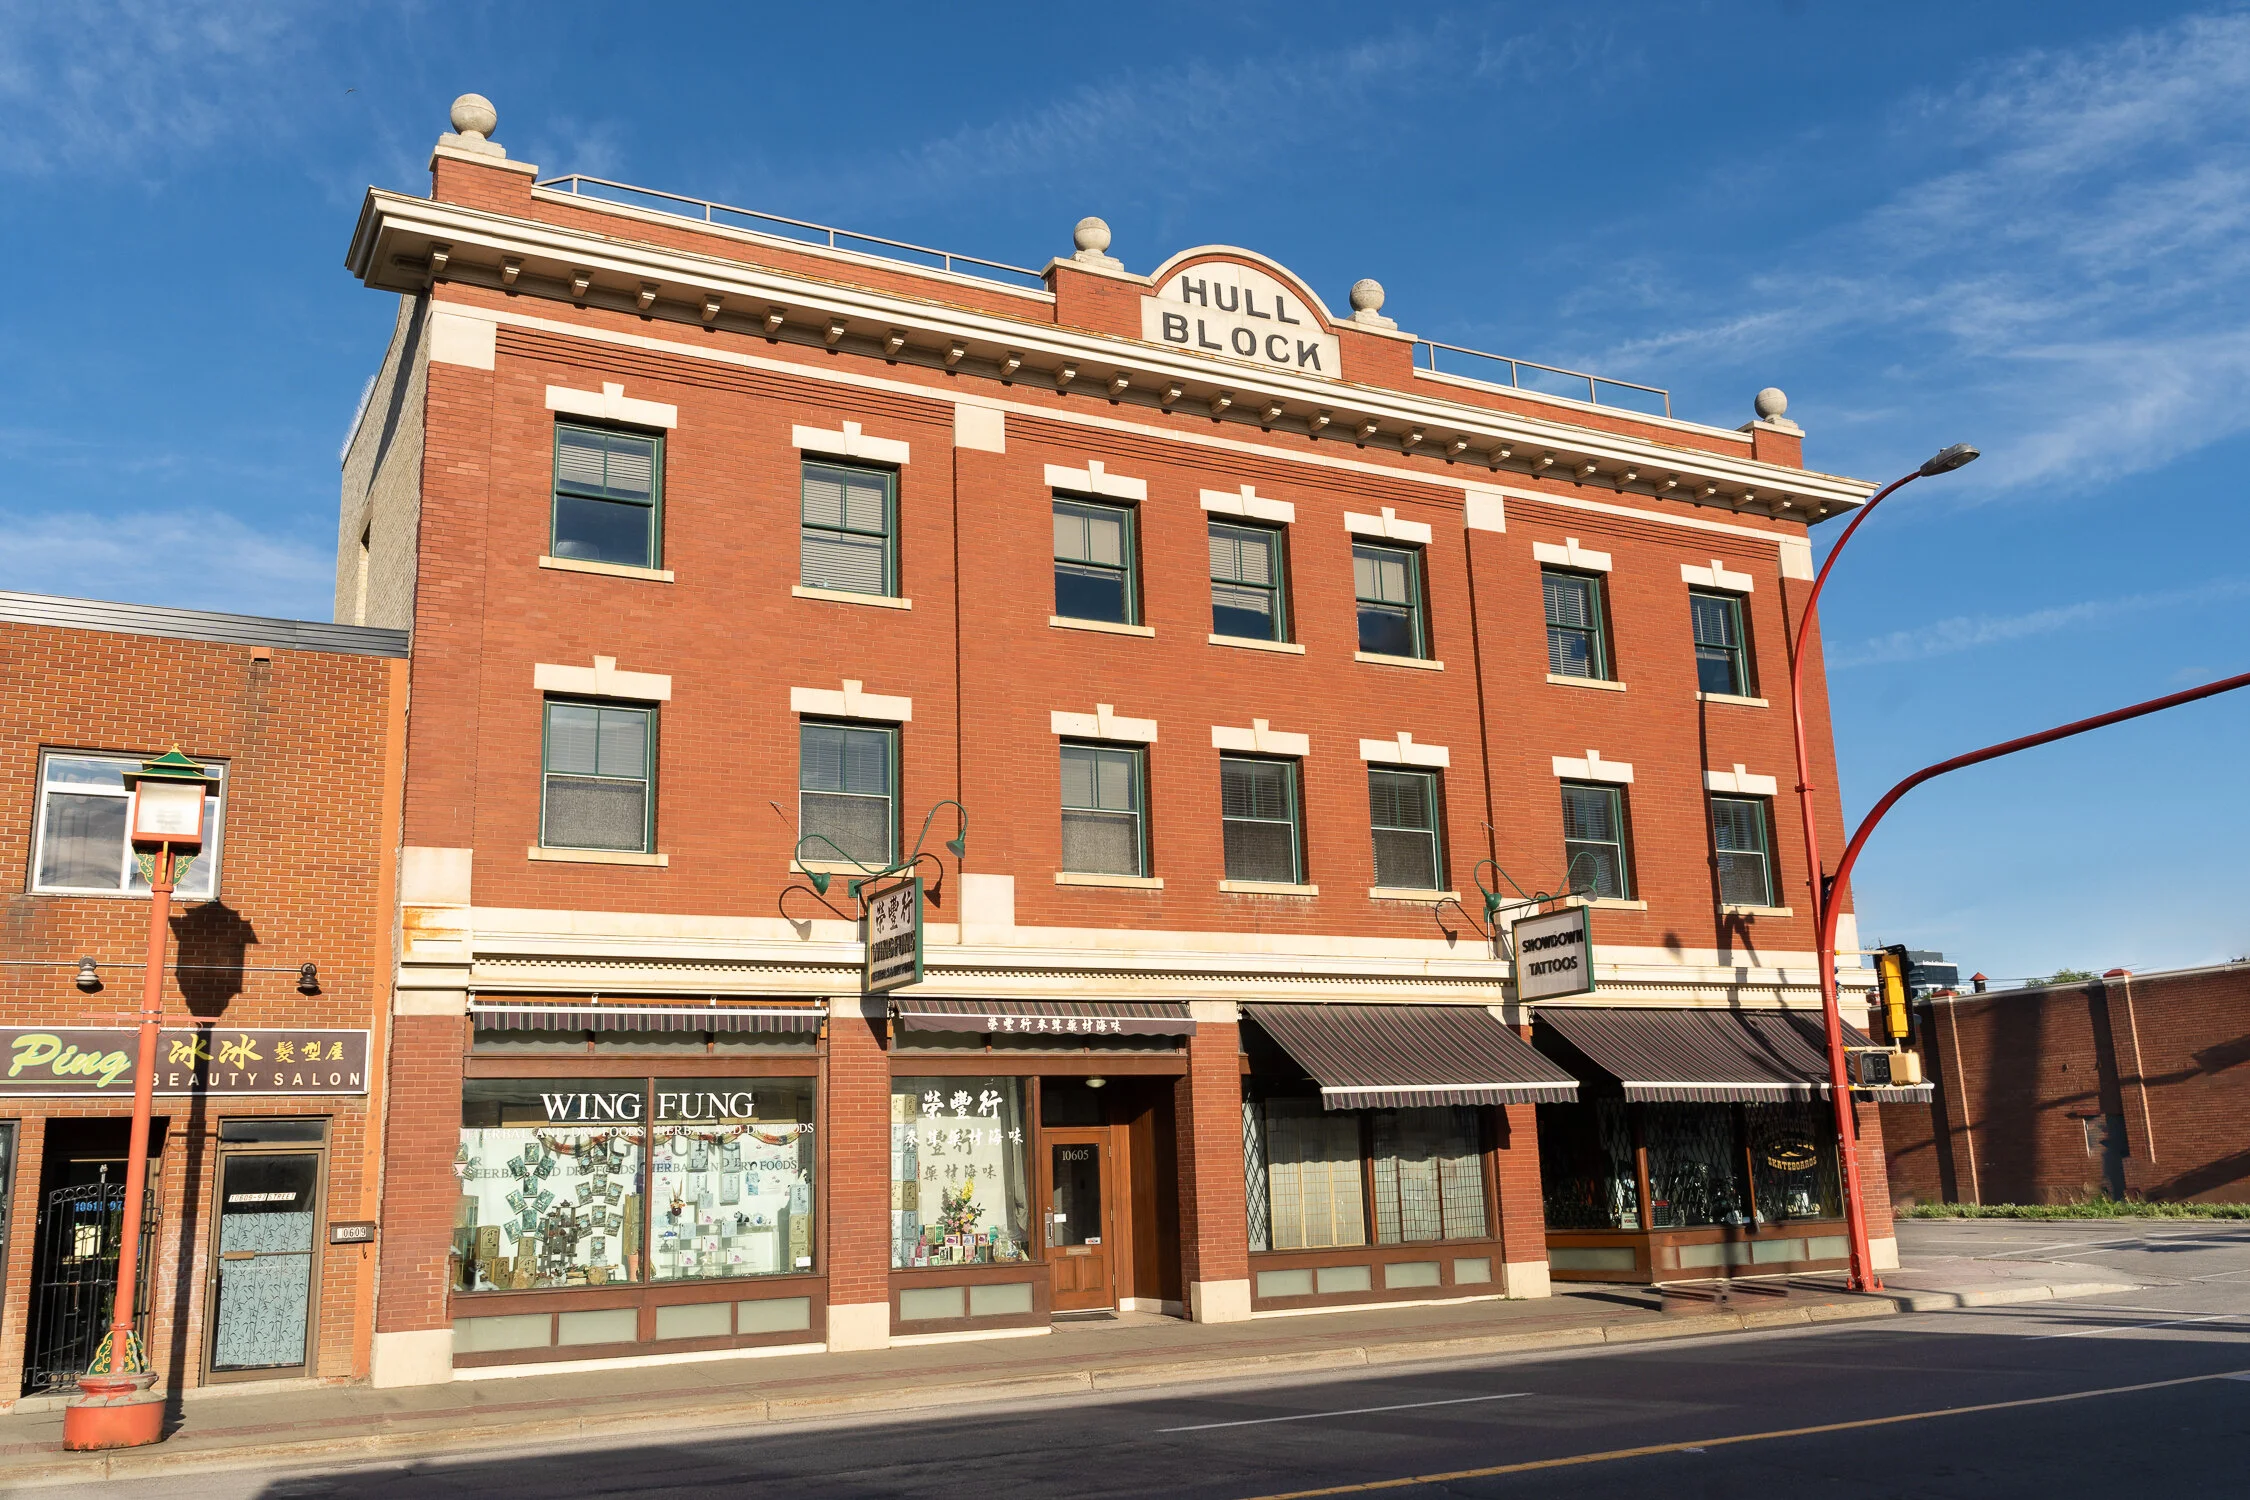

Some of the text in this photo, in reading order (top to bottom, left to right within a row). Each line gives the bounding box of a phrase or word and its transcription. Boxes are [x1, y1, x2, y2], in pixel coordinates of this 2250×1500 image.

[1181, 275, 1300, 325] HULL
[1162, 311, 1322, 371] BLOCK
[1521, 928, 1584, 954] SHOWDOWN
[1528, 955, 1578, 976] TATTOOS
[8, 1033, 132, 1088] Ping
[152, 1072, 360, 1087] BEAUTY SALON
[540, 1092, 755, 1121] WING FUNG
[536, 1126, 567, 1138] AND
[571, 1126, 594, 1138] DRY
[602, 1126, 644, 1137] FOODS
[657, 1125, 704, 1136] HERBAL
[716, 1124, 742, 1135] AND
[775, 1122, 814, 1134] FOODS
[1062, 1149, 1089, 1161] 10605
[1767, 1156, 1817, 1171] SKATEBOARDS
[267, 1192, 296, 1201] STREET
